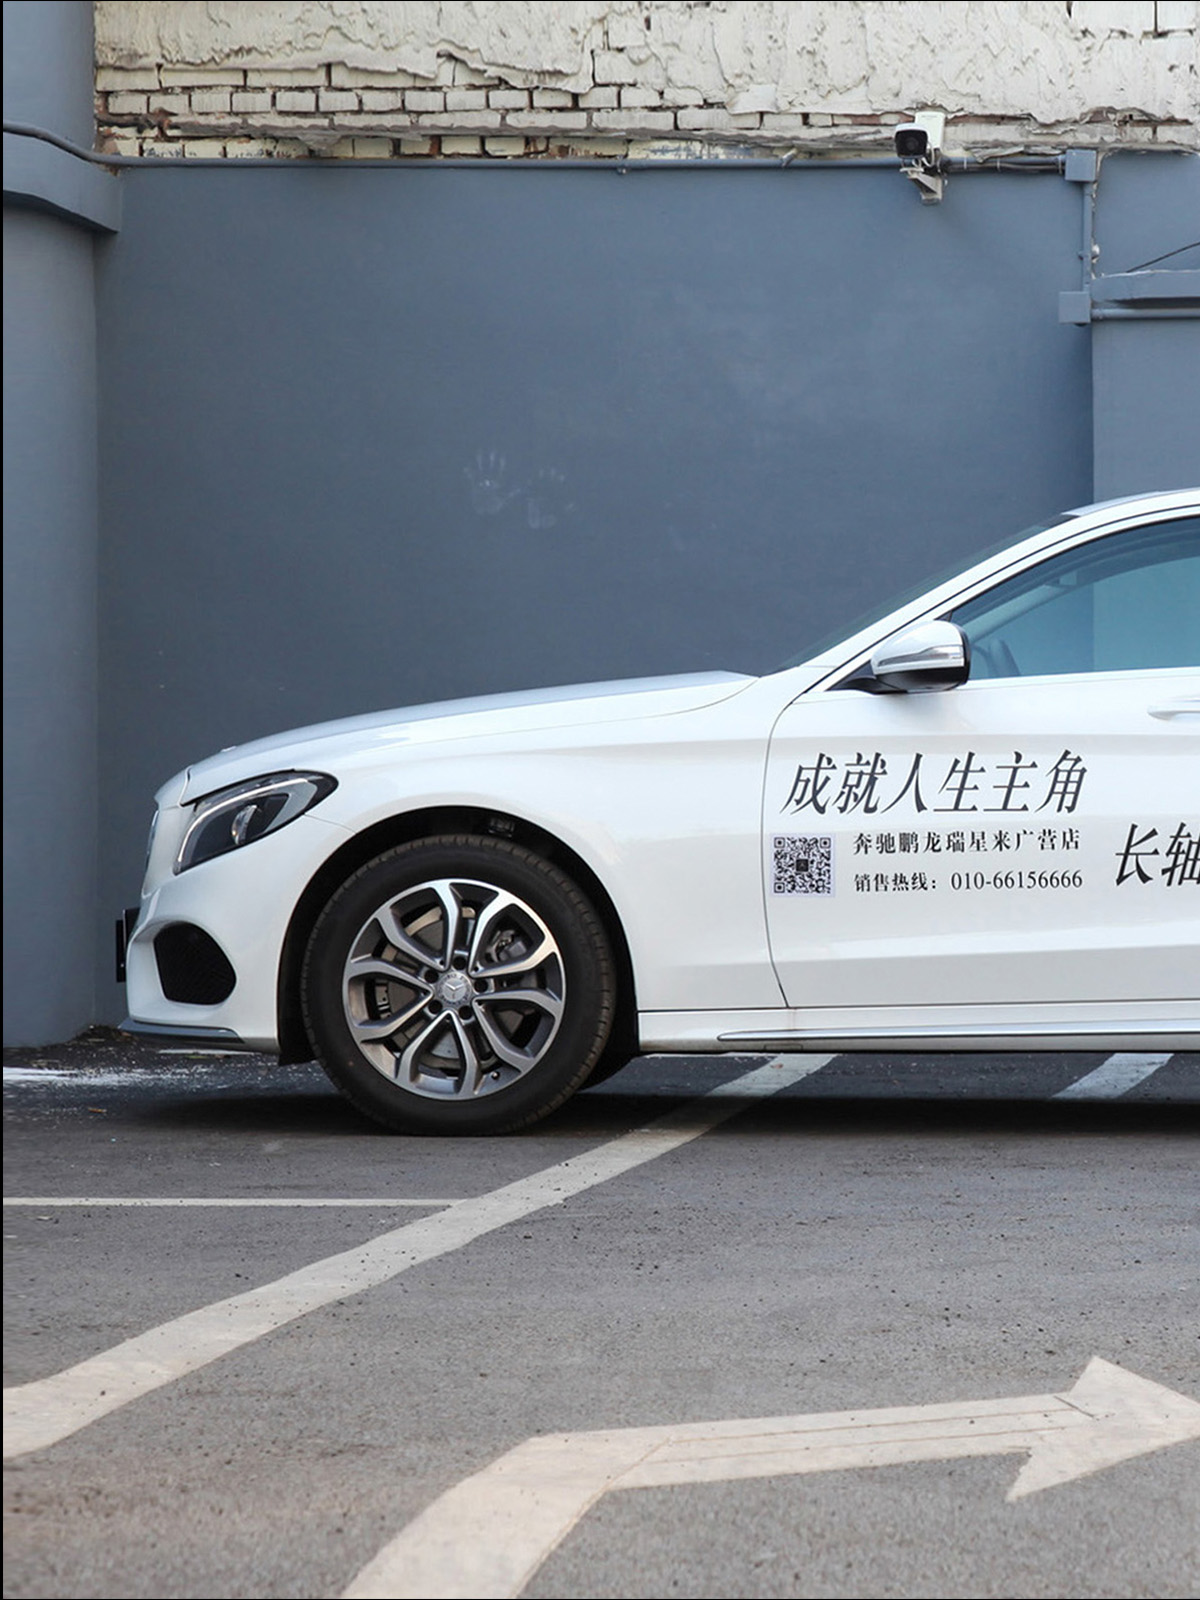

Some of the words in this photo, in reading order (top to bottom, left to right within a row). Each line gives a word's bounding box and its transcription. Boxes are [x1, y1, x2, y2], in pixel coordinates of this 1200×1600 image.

[779, 749, 1088, 815] 成就人生主角
[853, 827, 1080, 855] 奔驰鹏龙瑞星来广营店
